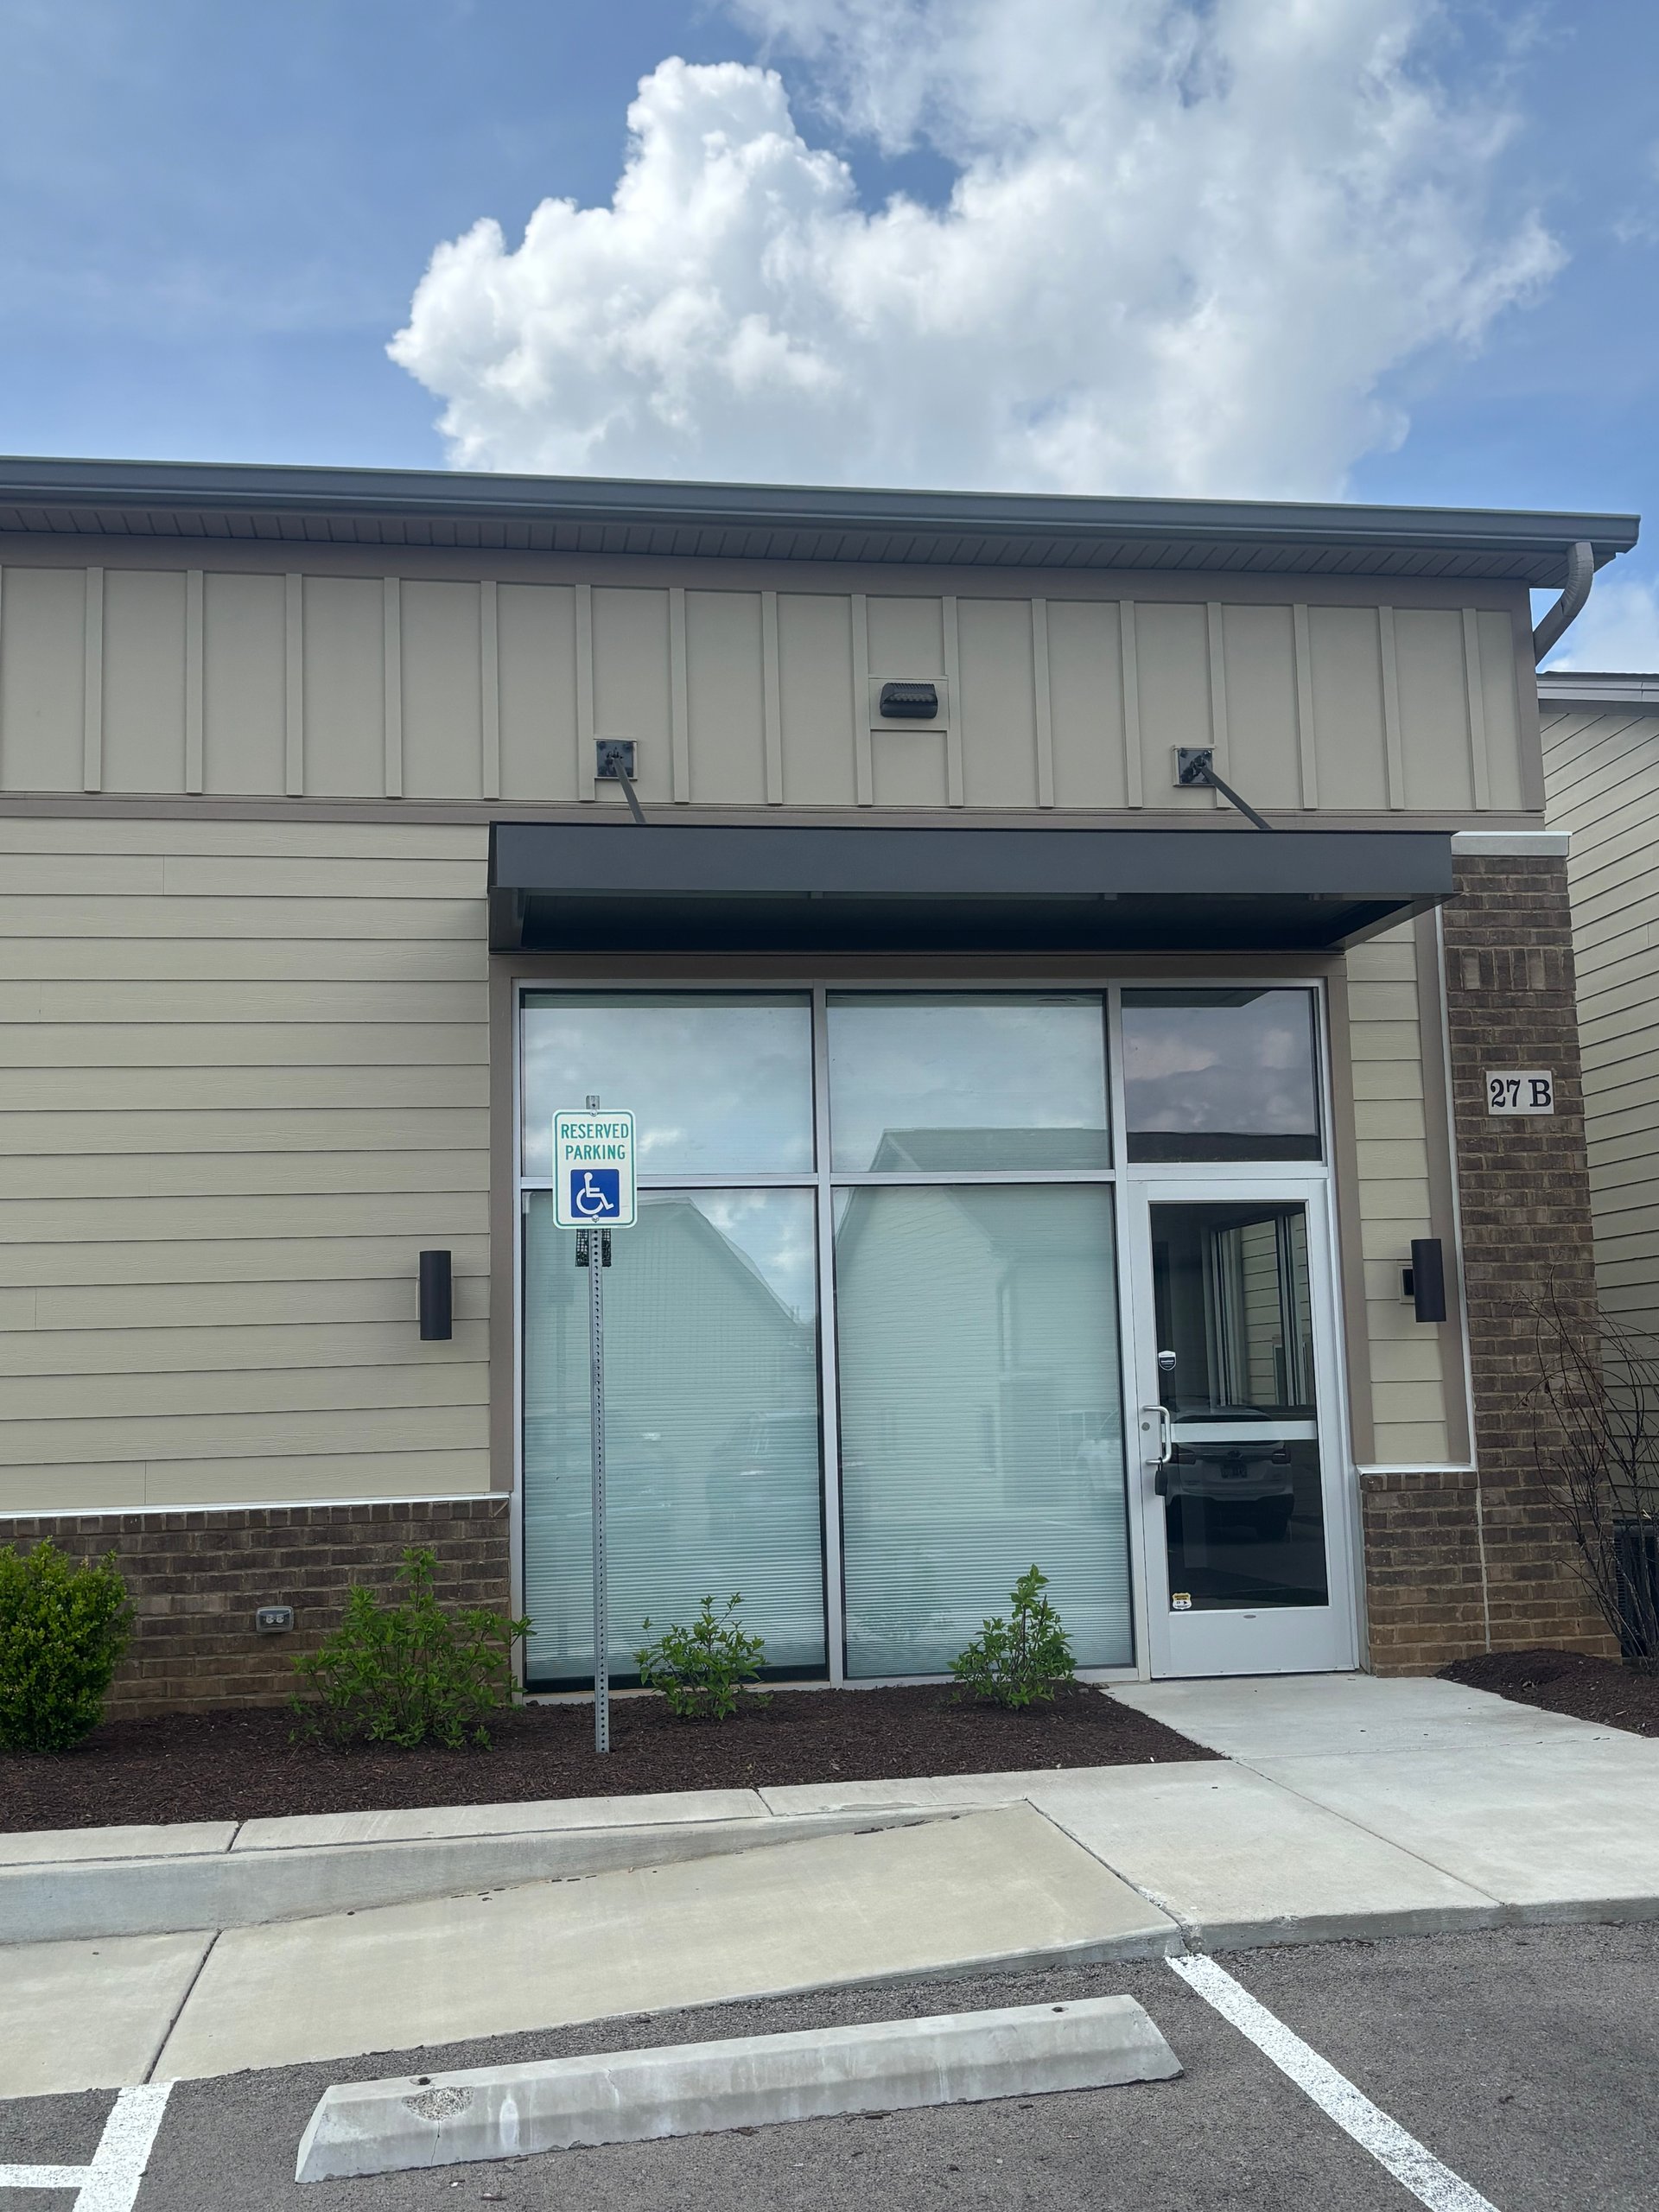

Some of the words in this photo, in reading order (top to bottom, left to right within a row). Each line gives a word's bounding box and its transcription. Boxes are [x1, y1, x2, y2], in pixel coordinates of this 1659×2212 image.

[1490, 1078, 1521, 1107] 27
[1528, 1079, 1552, 1107] B
[561, 1123, 629, 1139] RESERVED
[565, 1145, 626, 1160] PARKING
